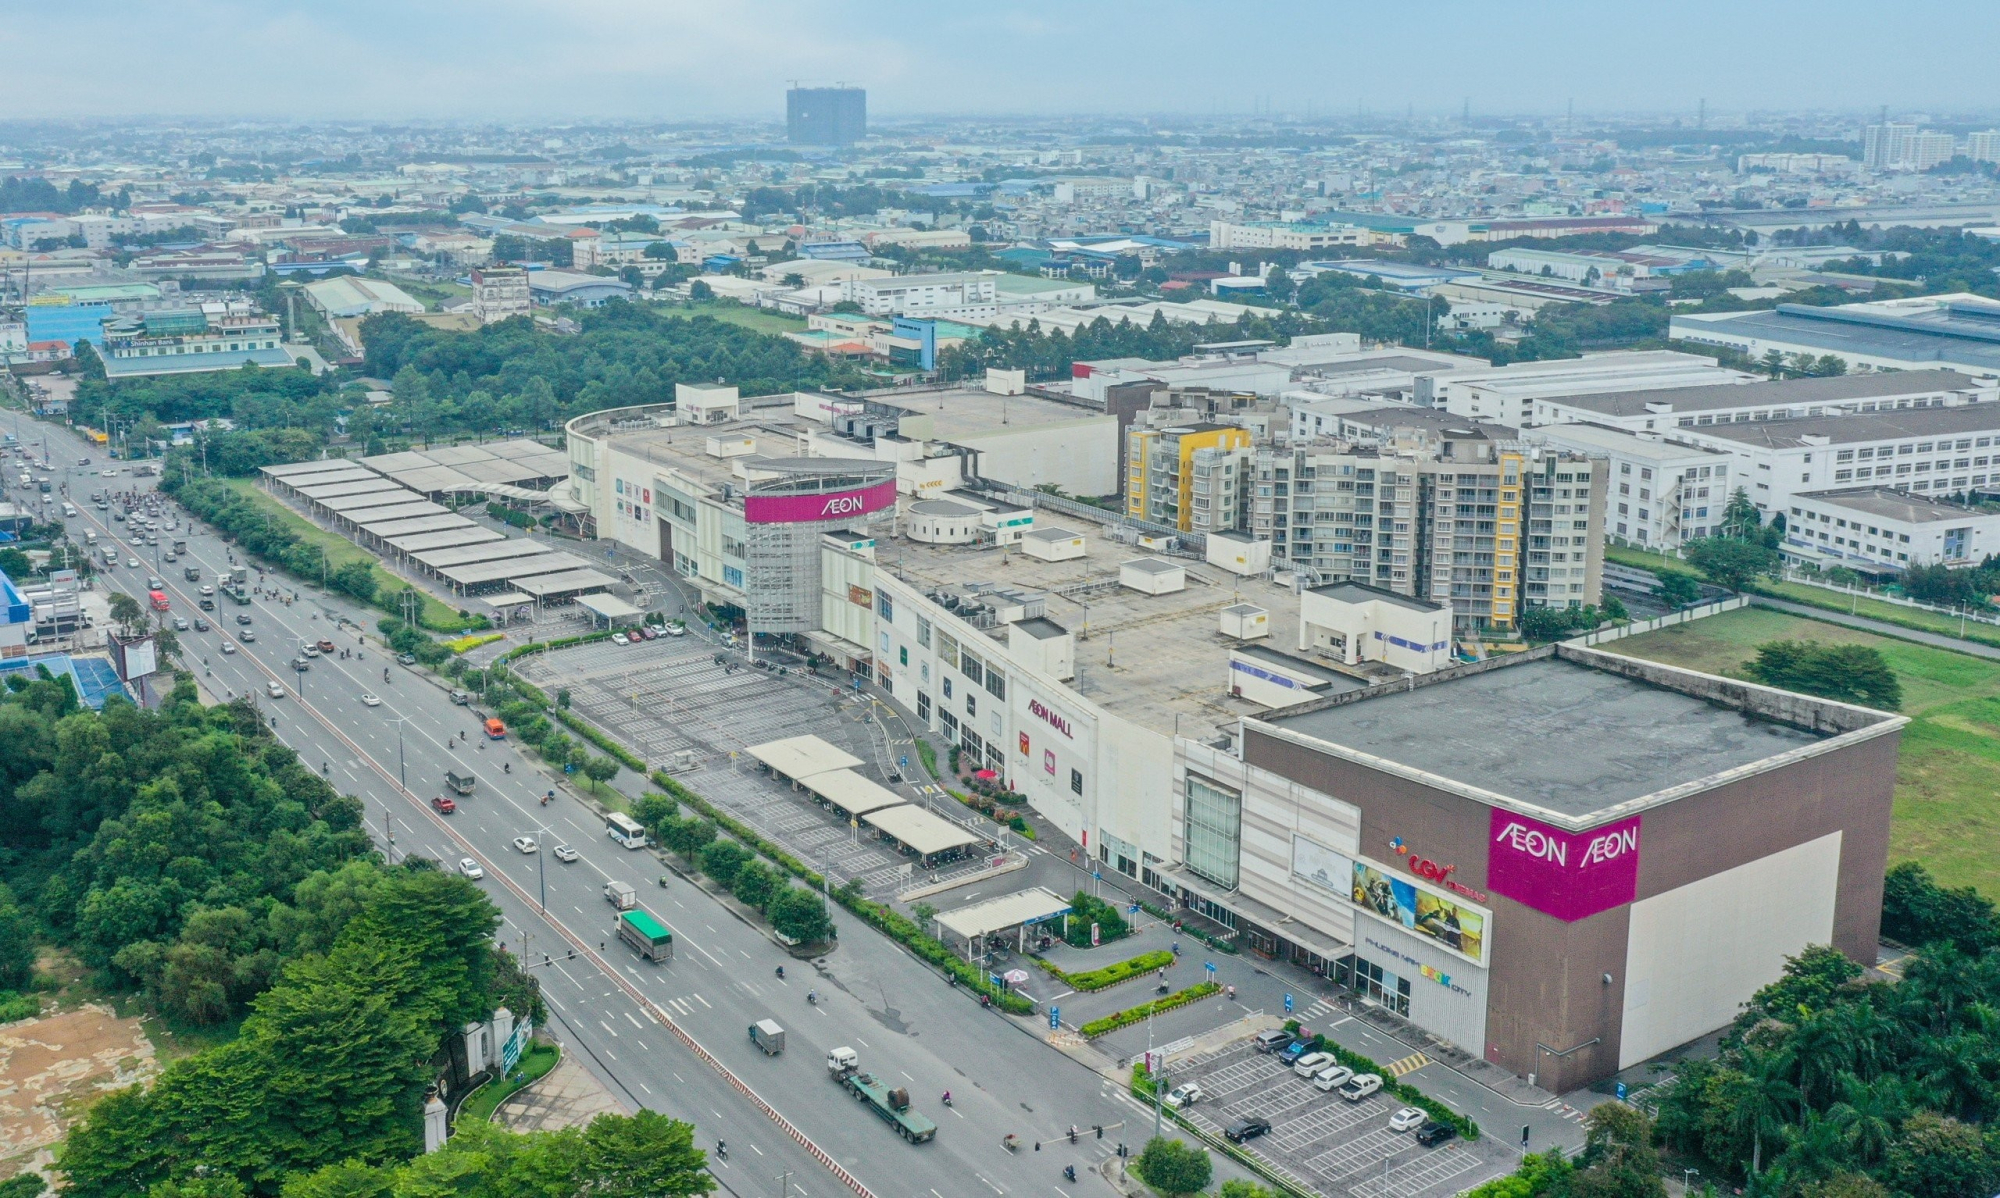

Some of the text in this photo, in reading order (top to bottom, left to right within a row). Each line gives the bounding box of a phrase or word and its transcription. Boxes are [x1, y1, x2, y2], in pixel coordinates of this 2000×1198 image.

[1049, 709, 1074, 740] MALL
[1408, 854, 1449, 884] CGV
[1420, 963, 1451, 988] BOOK
[1451, 984, 1472, 998] CITY
